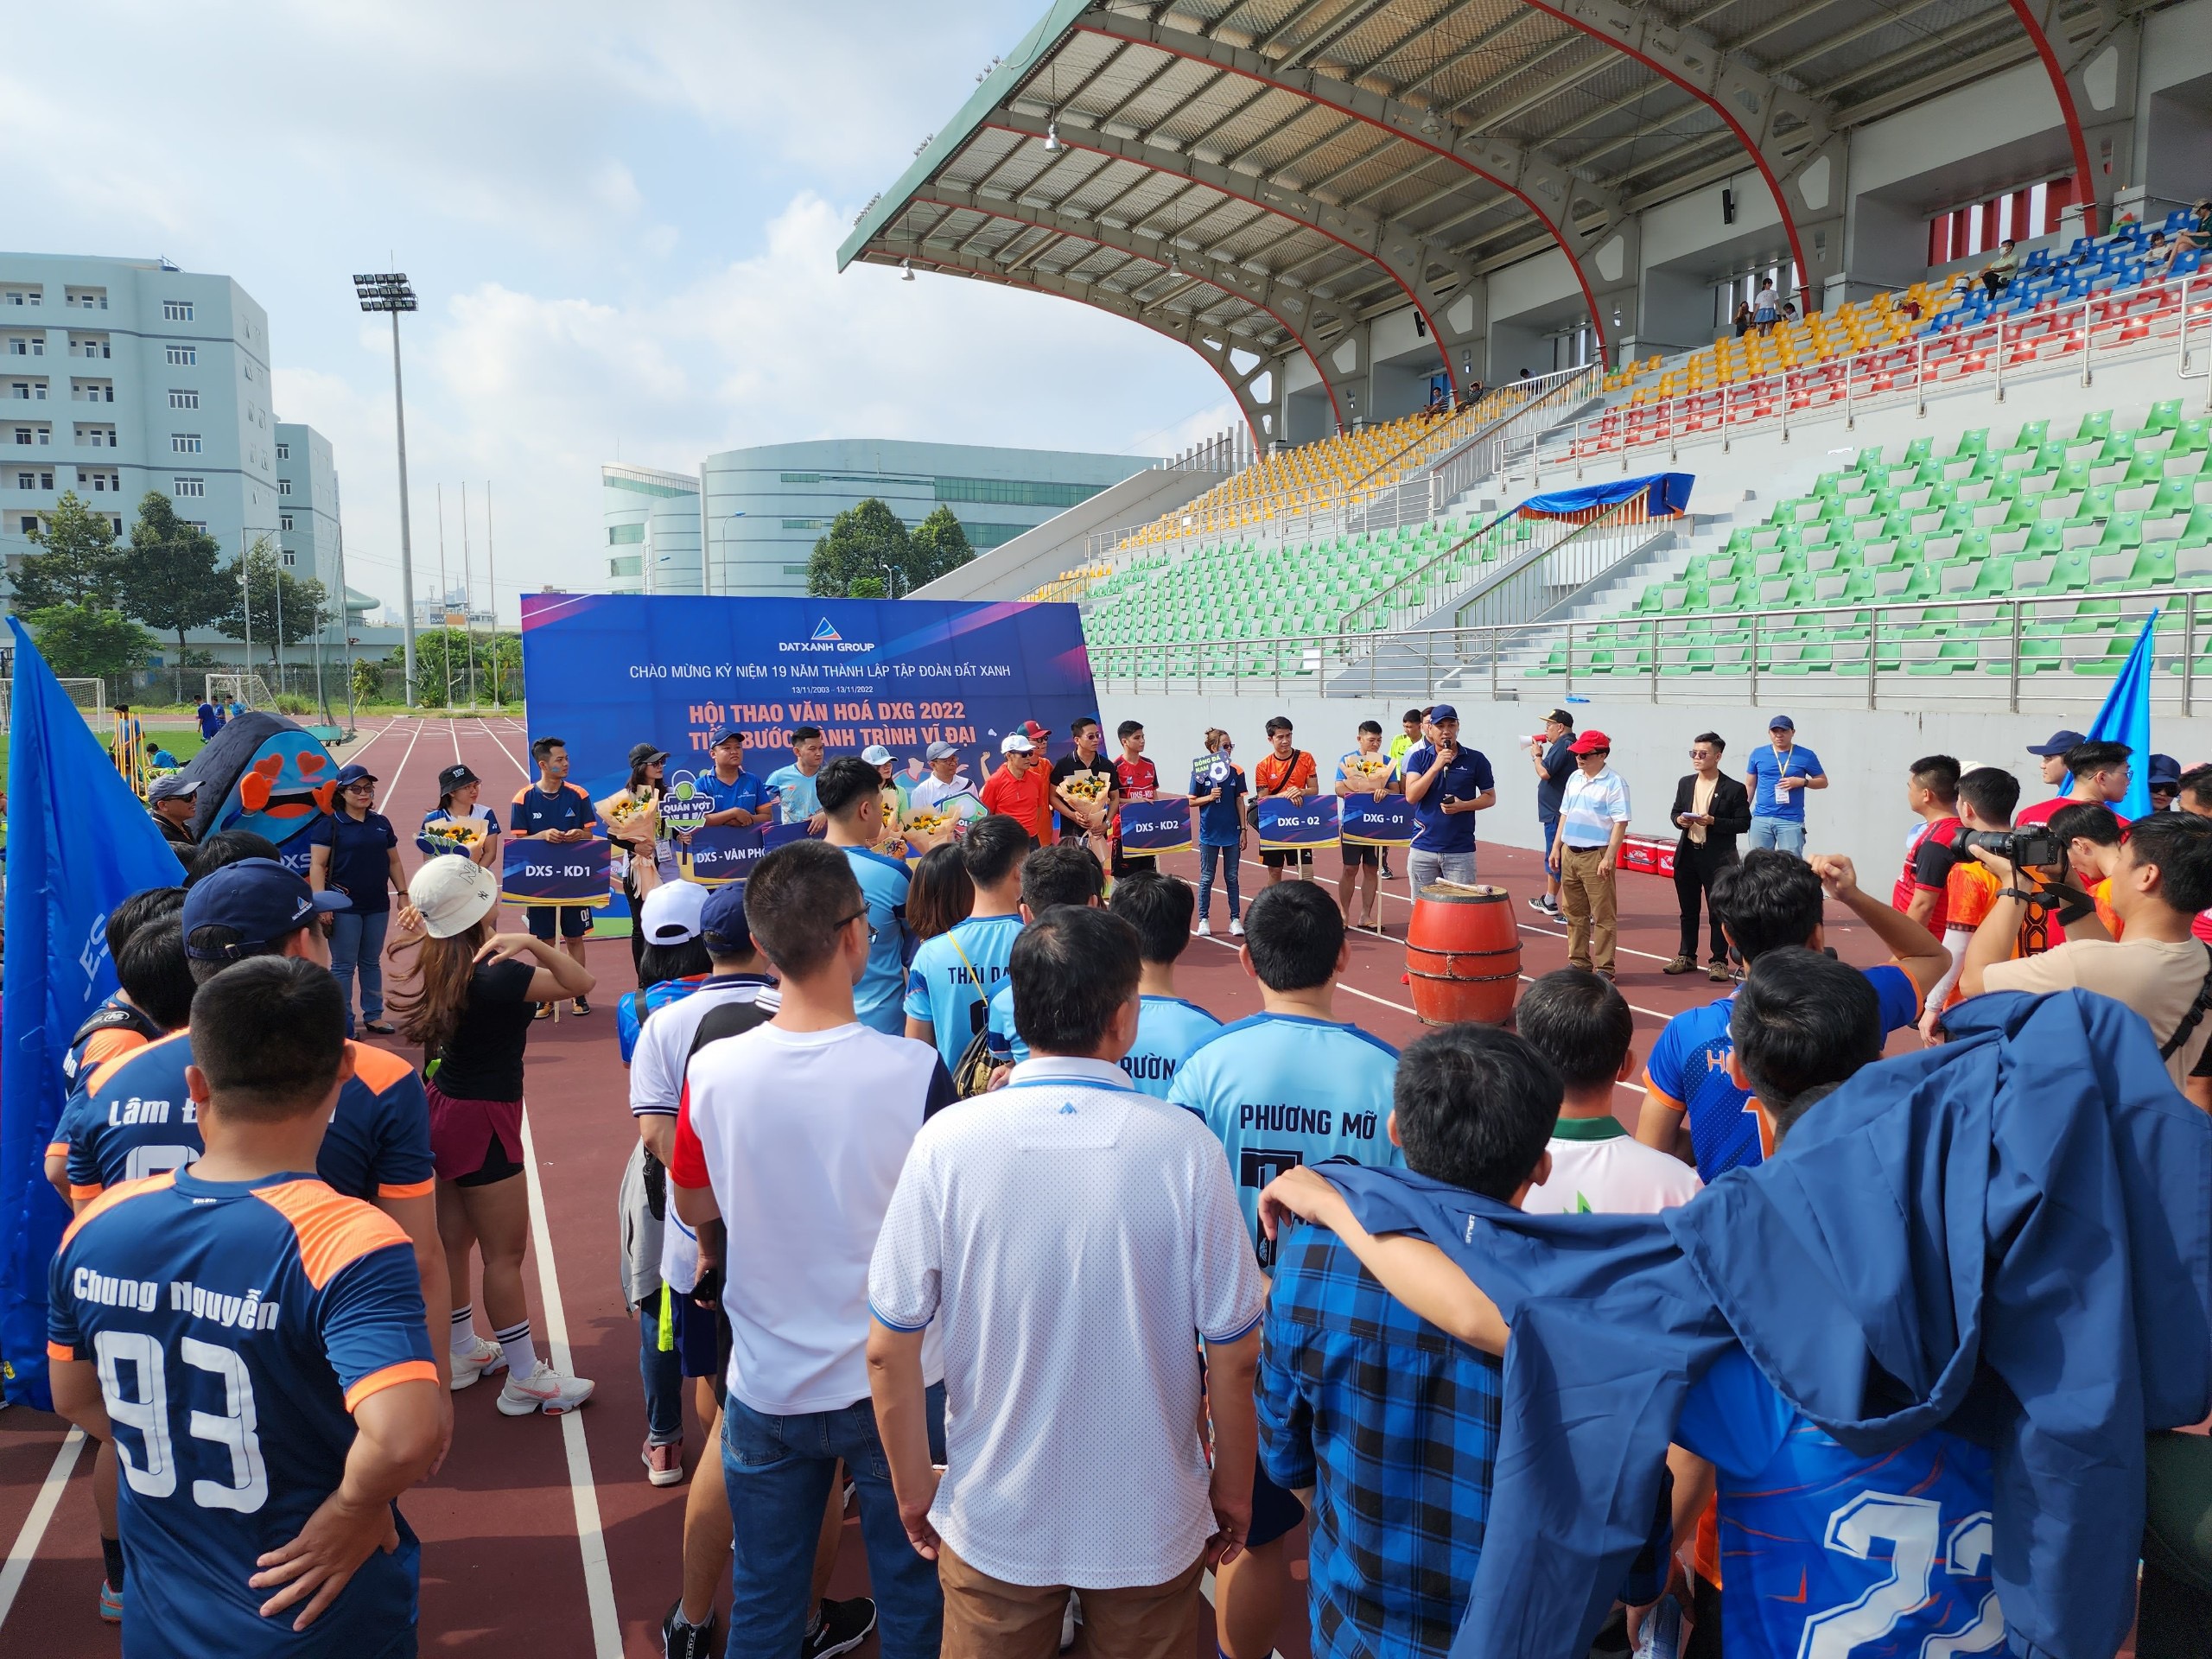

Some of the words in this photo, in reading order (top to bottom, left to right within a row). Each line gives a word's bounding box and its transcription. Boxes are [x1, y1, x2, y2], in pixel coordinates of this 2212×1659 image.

[779, 642, 834, 652] DATXANH
[836, 643, 875, 652] GROUP
[629, 663, 667, 678] CHÀO
[671, 663, 711, 678] MỪNG
[715, 662, 733, 677] KỶ
[736, 663, 768, 680] NIỆM
[772, 665, 787, 677] 19
[791, 664, 819, 677] NĂM
[822, 663, 864, 677] THÀNH
[868, 663, 890, 679] LẬP
[893, 663, 916, 679] TẬP
[918, 663, 951, 677] ĐOÀN
[954, 661, 977, 677] ĐẤT
[980, 665, 1011, 677] XANH
[836, 685, 874, 694] 13/11/2022
[690, 701, 725, 727] HỘI
[730, 704, 784, 723] THAO
[788, 700, 828, 721] VĂN
[834, 699, 874, 721] HOÁ
[878, 702, 915, 721] DXG
[919, 702, 966, 720] 2022
[818, 725, 855, 747] ÀNH
[860, 724, 918, 747] TRÌNH
[920, 722, 940, 744] VĨ
[944, 725, 976, 747] ĐẠI
[1194, 759, 1211, 767] BÓNG
[1211, 753, 1221, 762] ĐÁ
[1195, 765, 1210, 773] NAM
[692, 801, 711, 812] VỢT
[1277, 817, 1300, 827] DXG
[1306, 817, 1320, 825] 02
[1363, 813, 1384, 823] DXG
[1392, 815, 1404, 823] 01
[1135, 822, 1154, 833] DXS
[1160, 820, 1179, 830] KD2
[280, 853, 312, 868] XS
[696, 852, 717, 863] DXS
[724, 848, 745, 861] VĂN
[525, 865, 554, 877] DXS
[564, 866, 590, 877] KD1
[947, 963, 985, 984] THÁI
[1120, 1052, 1176, 1081] RƯỜN
[108, 1096, 170, 1127] Lâm
[1240, 1103, 1332, 1135] PHƯƠNG
[1341, 1109, 1378, 1141] MỠ
[73, 1267, 158, 1313] Chung
[170, 1281, 280, 1331] Nguyễn
[93, 1330, 269, 1514] 93
